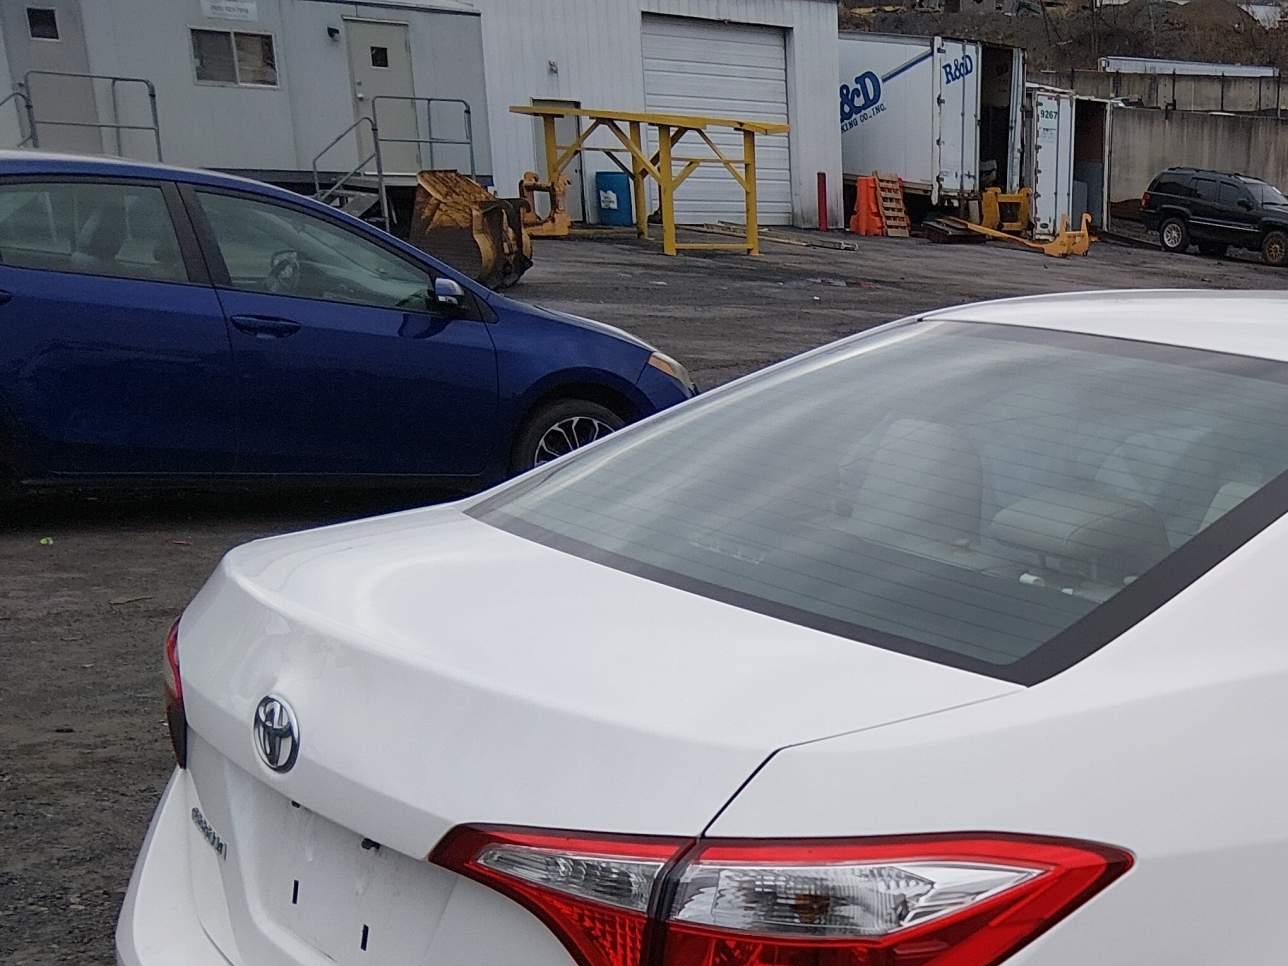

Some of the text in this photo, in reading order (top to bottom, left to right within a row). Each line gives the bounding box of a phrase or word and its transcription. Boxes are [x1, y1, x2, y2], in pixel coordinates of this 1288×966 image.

[942, 54, 973, 84] R&D
[840, 71, 881, 123] &D
[1040, 110, 1058, 119] 9267
